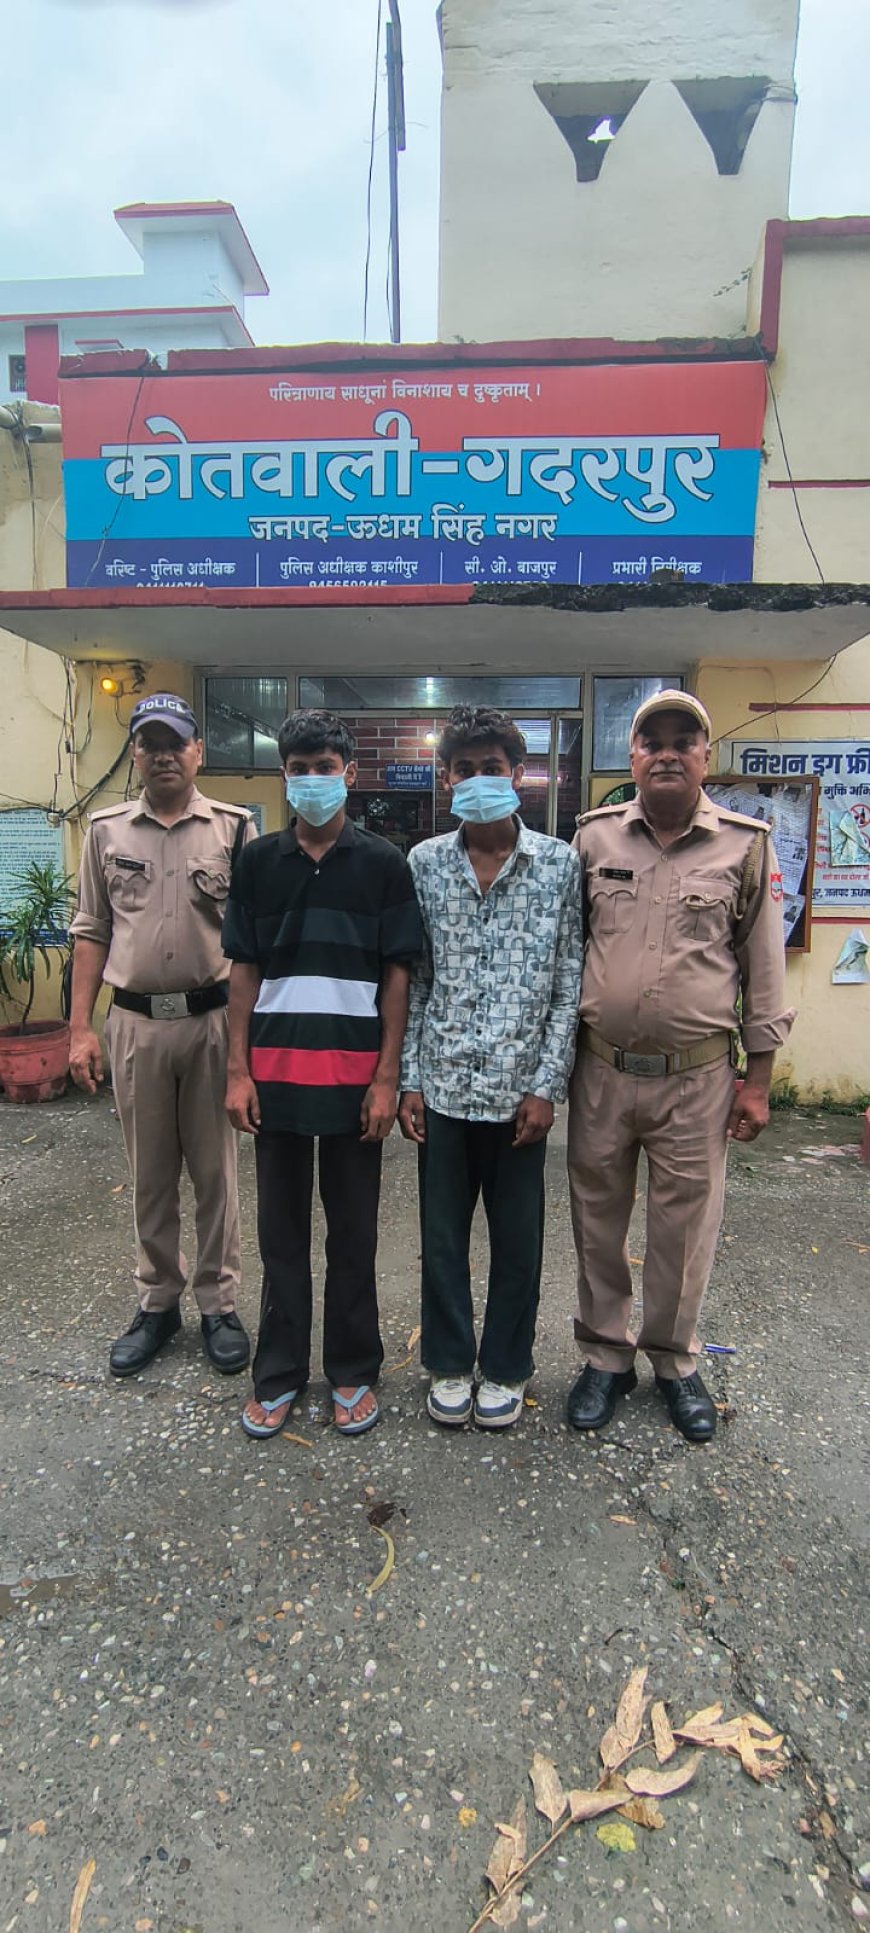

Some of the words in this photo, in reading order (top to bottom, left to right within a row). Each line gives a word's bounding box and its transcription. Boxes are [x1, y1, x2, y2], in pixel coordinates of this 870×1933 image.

[341, 379, 387, 405] साधूनां
[392, 379, 453, 399] विनाशाय
[457, 384, 470, 397] च
[248, 514, 422, 543] जनपद-ऊधम
[431, 503, 487, 546] सिंह
[494, 514, 558, 541] नगर
[150, 558, 183, 580] पुलिस
[280, 556, 314, 579] पुलिस
[318, 556, 367, 575] अधीक्षक
[371, 556, 418, 578] काशीपुर
[464, 555, 485, 575] सी.
[491, 555, 512, 574] ओ.
[612, 556, 647, 575] प्रभारी
[740, 748, 808, 774] मिशन
